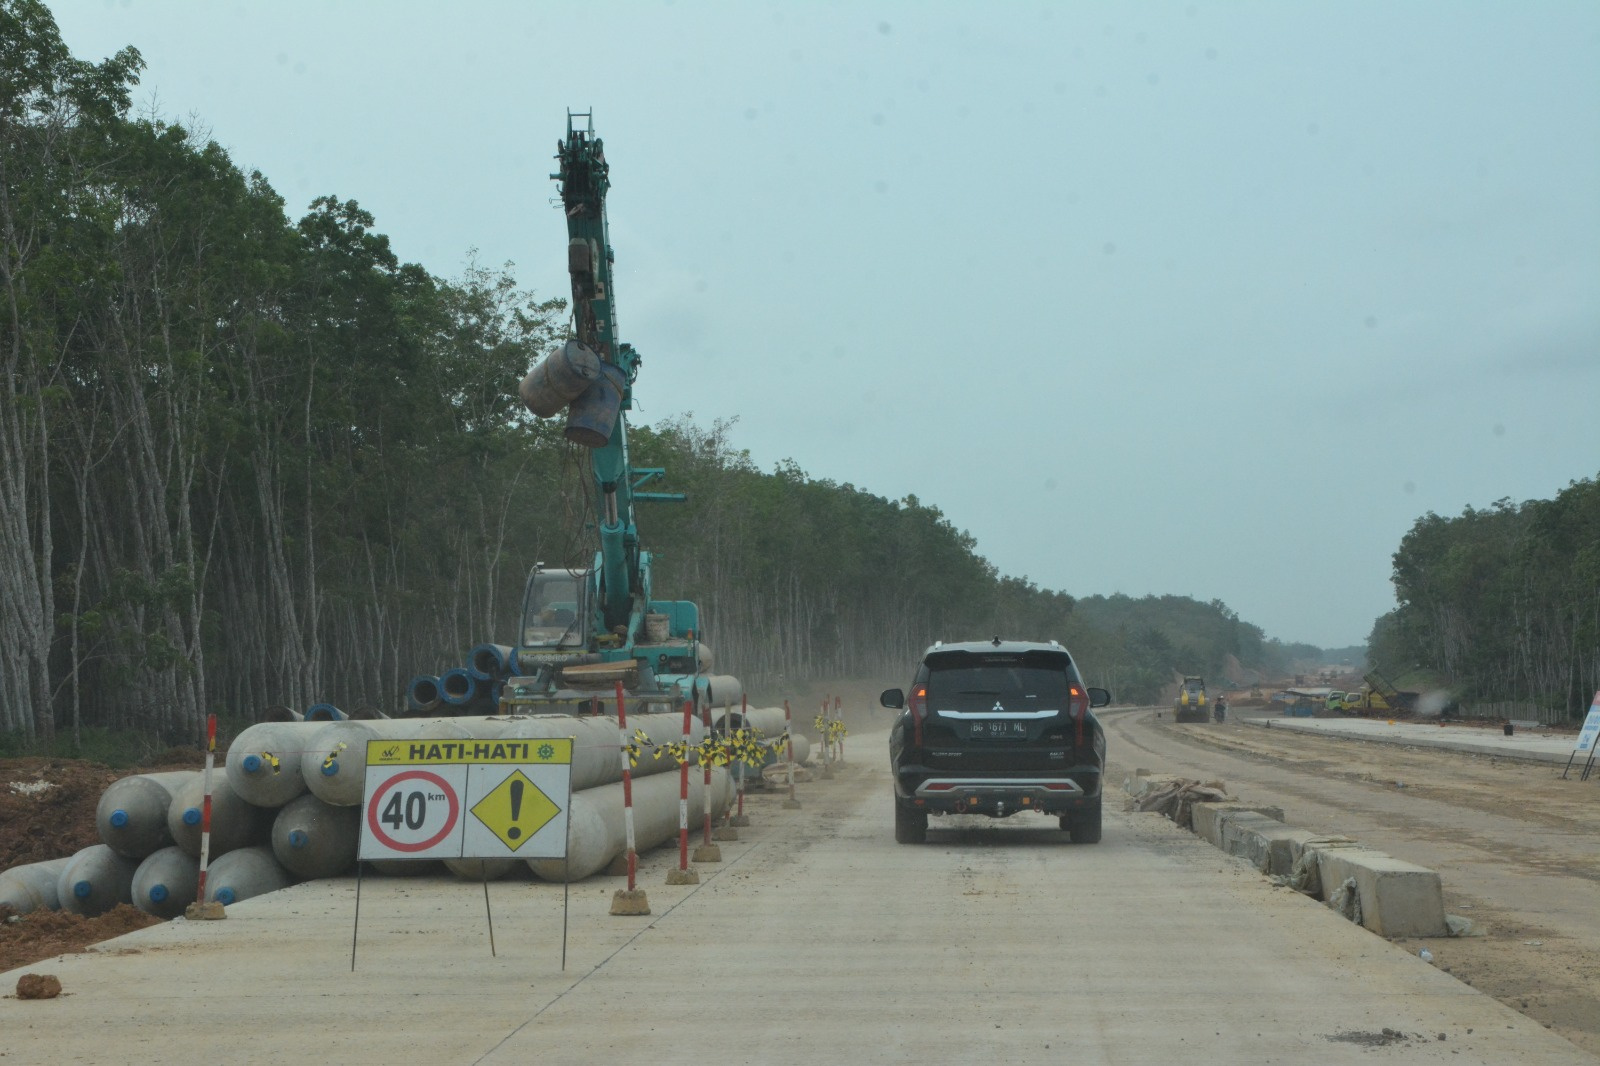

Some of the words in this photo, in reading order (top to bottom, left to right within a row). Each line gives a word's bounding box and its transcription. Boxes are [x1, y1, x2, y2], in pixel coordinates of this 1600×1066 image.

[1013, 722, 1025, 732] ML
[409, 743, 529, 760] HATI-HATI
[381, 791, 426, 831] 40
[427, 792, 446, 801] km
